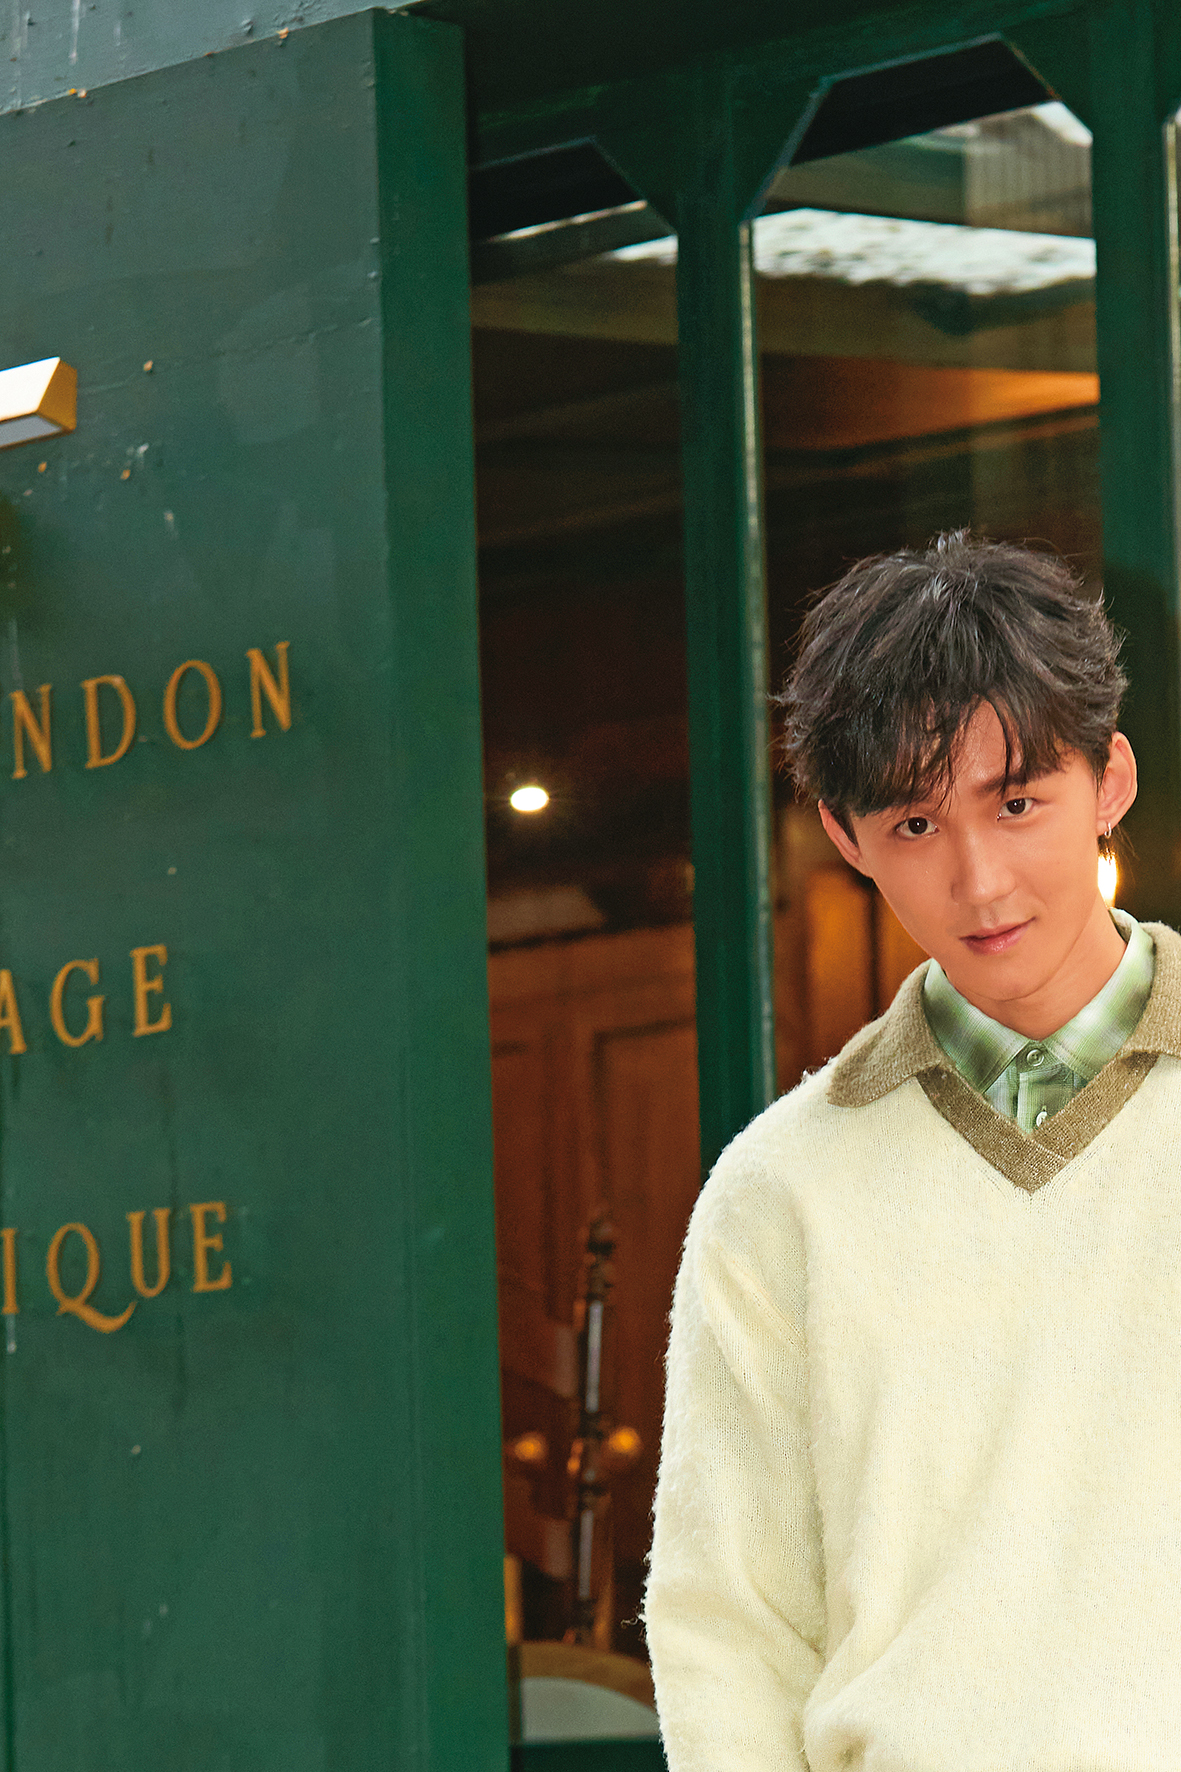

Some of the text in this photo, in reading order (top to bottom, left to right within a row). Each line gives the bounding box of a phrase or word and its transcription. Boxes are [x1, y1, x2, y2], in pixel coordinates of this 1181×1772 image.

[8, 640, 292, 779] NDON
[0, 943, 173, 1055] AGE
[0, 1201, 233, 1333] IQUE
